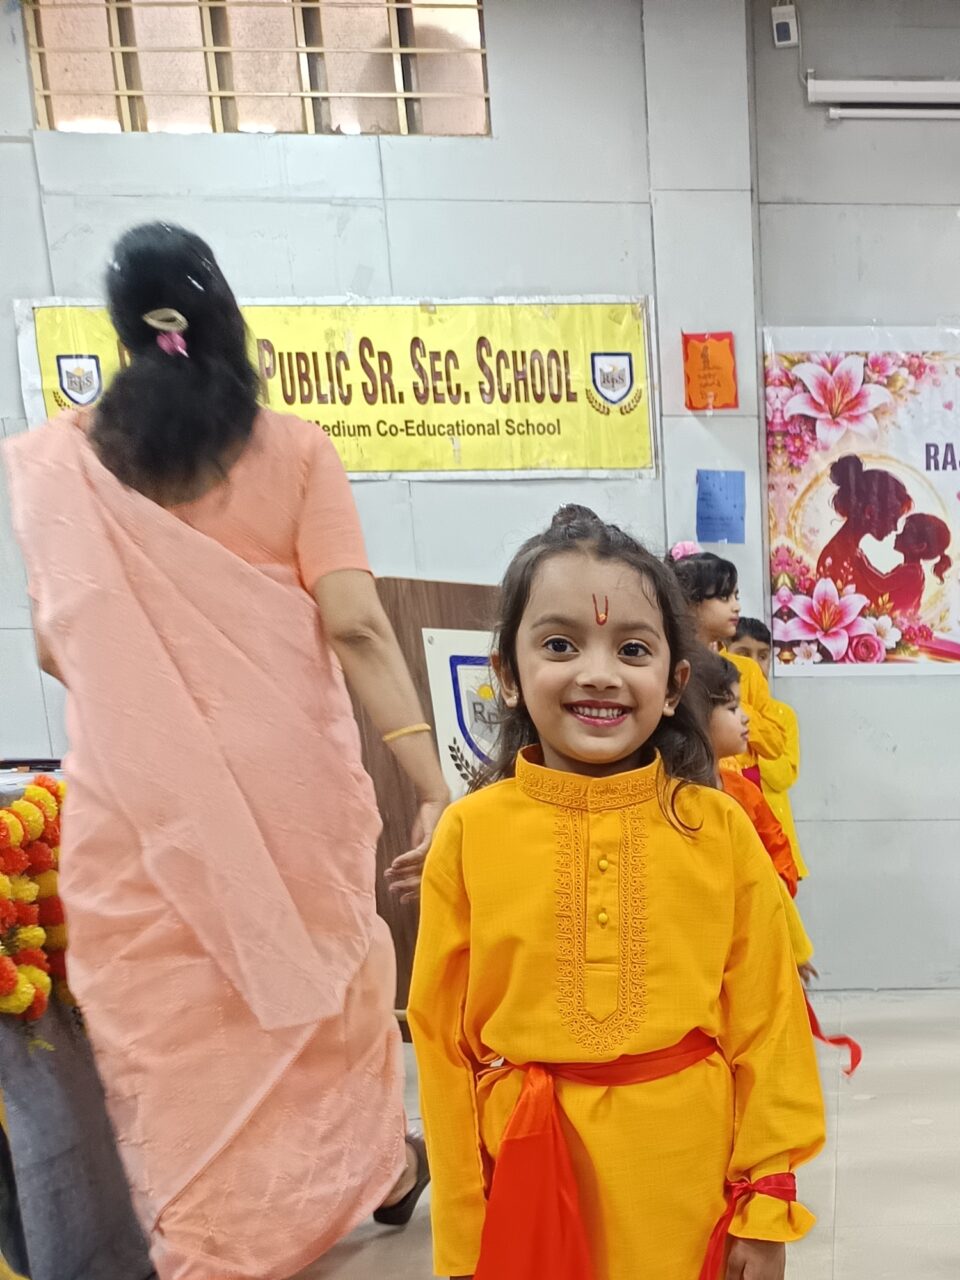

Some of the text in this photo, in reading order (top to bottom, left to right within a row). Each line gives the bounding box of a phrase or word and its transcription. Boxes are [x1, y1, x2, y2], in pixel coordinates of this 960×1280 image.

[257, 336, 578, 406] PUBLIC SR. SEC. SCHOOL
[307, 418, 561, 437] edium Co-Educational School
[473, 702, 500, 733] RP
